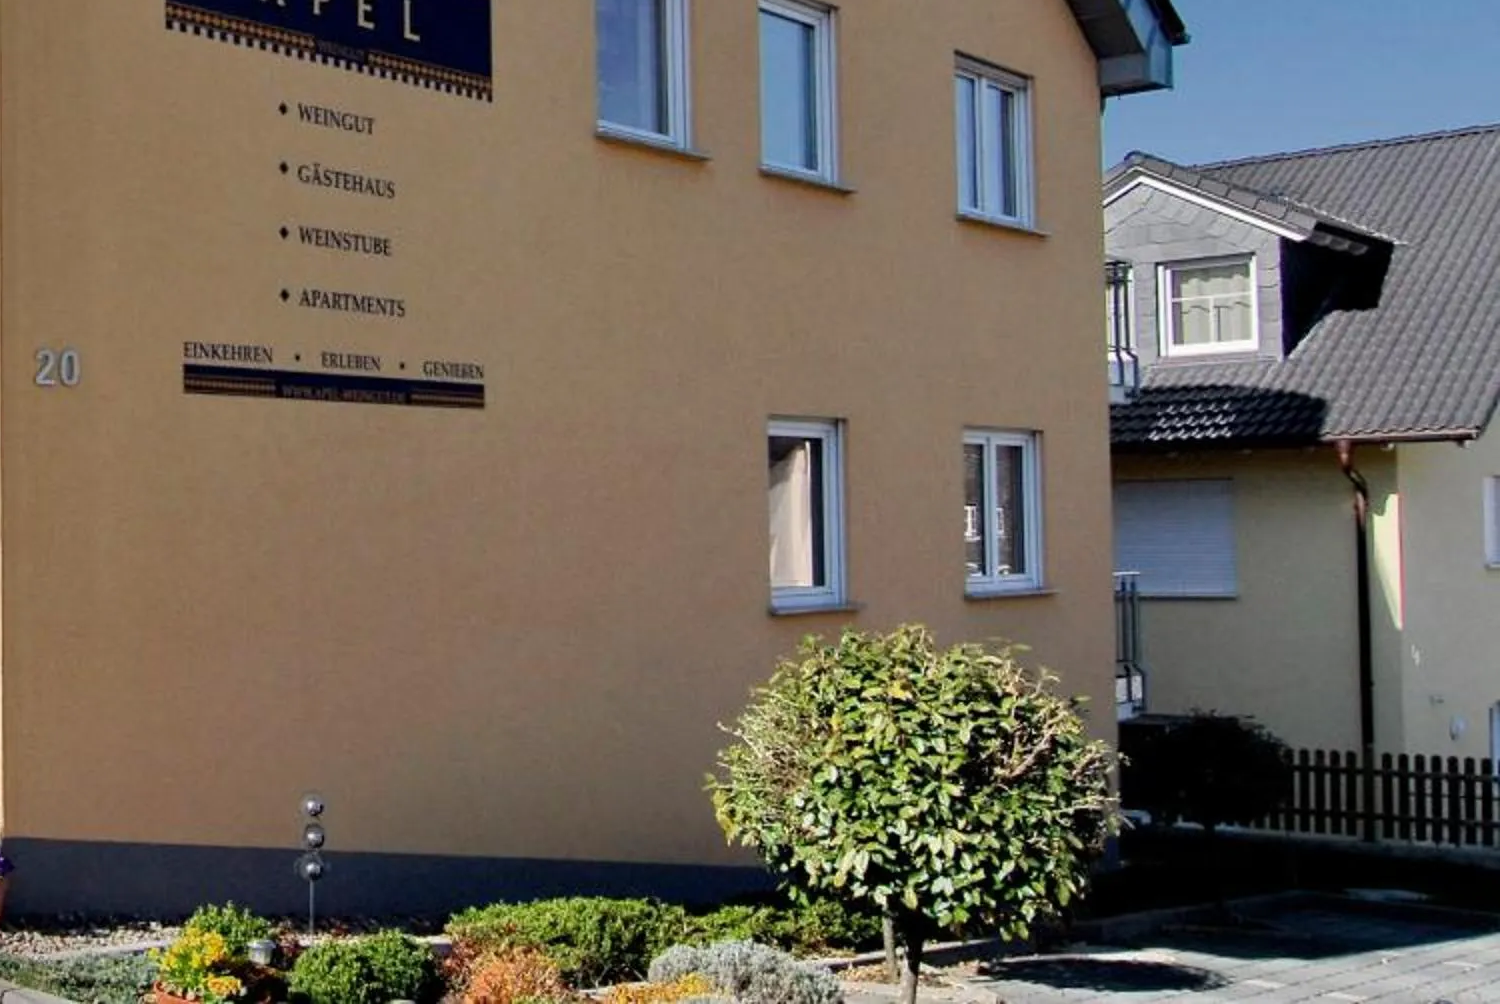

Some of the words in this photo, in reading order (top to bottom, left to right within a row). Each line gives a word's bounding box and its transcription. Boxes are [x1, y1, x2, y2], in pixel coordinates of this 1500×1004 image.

[297, 102, 375, 135] WEINGUT
[297, 163, 396, 199] GÄSTEHAUS
[299, 225, 392, 257] WEINSTUBE
[299, 288, 406, 318] APARTMENTS
[34, 347, 80, 386] 20
[183, 341, 273, 364] EINKEHREN
[321, 350, 381, 372] ERLEBEN
